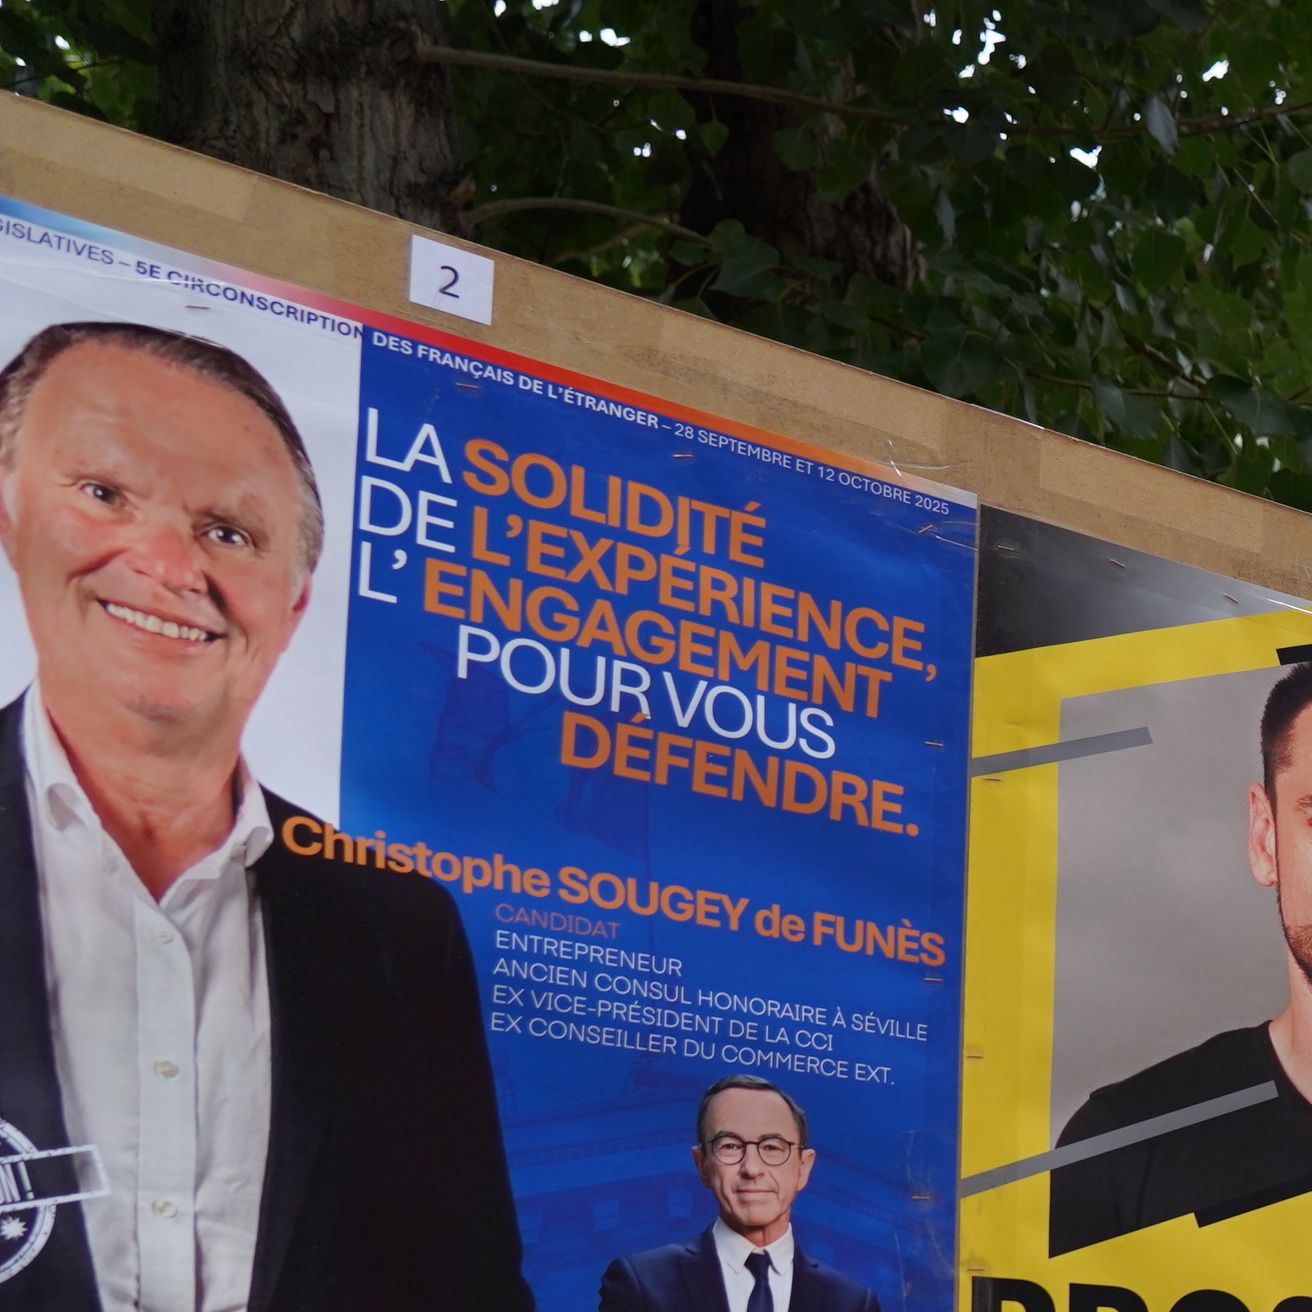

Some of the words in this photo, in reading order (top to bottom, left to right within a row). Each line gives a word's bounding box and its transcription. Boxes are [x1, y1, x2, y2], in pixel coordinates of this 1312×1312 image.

[439, 265, 460, 298] 2
[136, 260, 161, 279] 5E
[167, 271, 363, 339] CIRCONSCRIPTION
[373, 330, 413, 356] DES
[417, 341, 514, 385] FRANÇAIS
[519, 374, 542, 395] DE
[548, 384, 659, 428] L'ÉTRANGER
[674, 423, 694, 439] 28
[698, 429, 791, 469] SEPTEMBRE
[796, 456, 812, 473] ET
[817, 464, 834, 481] 12
[839, 469, 911, 504] OCTOBRE
[915, 493, 949, 514] 2025
[366, 407, 452, 483] LA
[462, 439, 766, 568] SOLIDITÉ
[358, 541, 407, 604] L'
[424, 557, 892, 717] ENGAGEMENT
[359, 475, 457, 552] DE
[471, 506, 938, 682] L'EXPÉRIENCE,
[457, 624, 653, 719] POUR
[664, 672, 835, 758] VOUS
[560, 710, 919, 837] DÉFENDRE.
[282, 817, 550, 899] Christophe
[557, 865, 748, 931] SOUGEY
[755, 903, 806, 943] de
[814, 908, 946, 967] FUNÈS
[496, 903, 620, 939] CANDIDAT
[496, 930, 682, 976] ENTREPRENEUR
[491, 1012, 522, 1033] EX
[528, 1019, 676, 1055] CONSEILLER
[684, 1039, 715, 1060] DU
[722, 1044, 848, 1078] COMMERCE
[855, 1064, 894, 1085] EXT.
[493, 958, 587, 988] ANCIEN
[594, 973, 688, 1007] CONSUL
[698, 989, 826, 1025] HONORAIRE
[832, 1005, 846, 1027] À
[851, 1010, 927, 1041] SÉVILLE
[493, 985, 524, 1005] EX
[530, 991, 722, 1033] VICE-PRÉSIDENT
[729, 1020, 757, 1038] DE
[765, 1025, 790, 1043] LA
[795, 1029, 833, 1051] CCI
